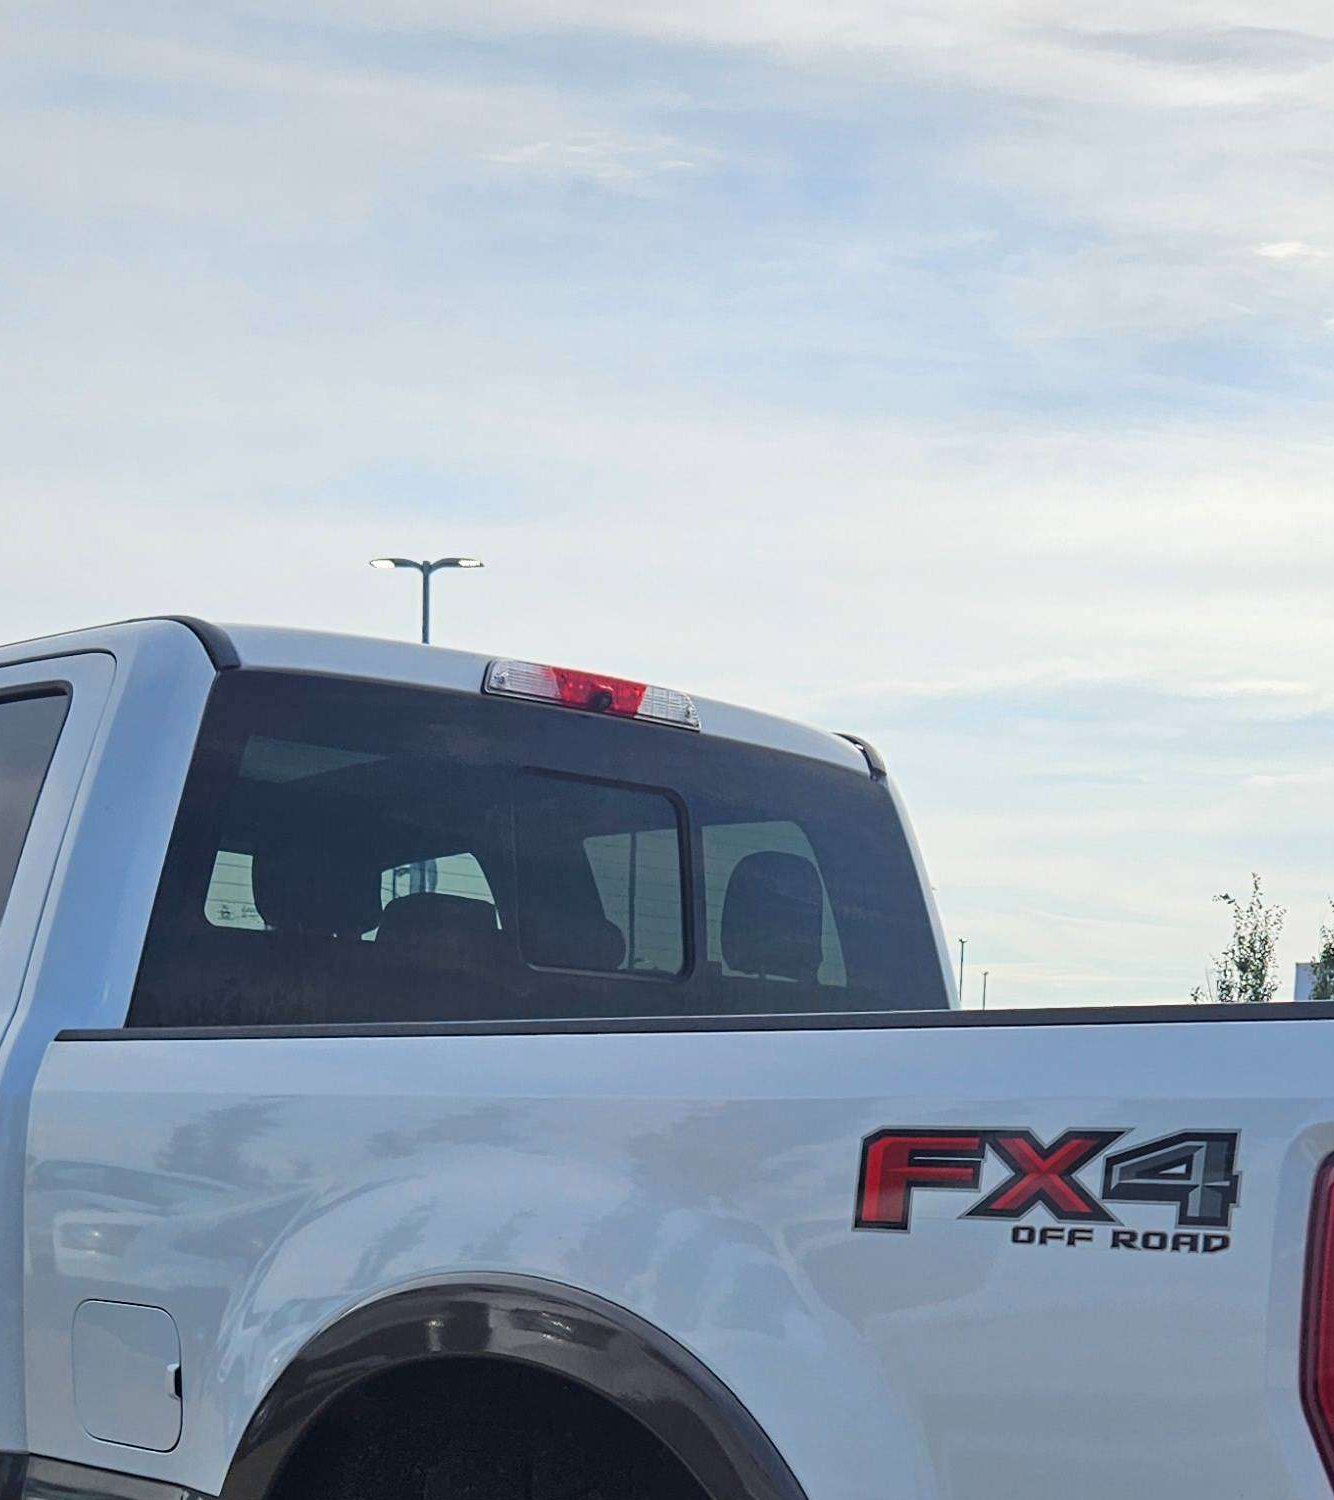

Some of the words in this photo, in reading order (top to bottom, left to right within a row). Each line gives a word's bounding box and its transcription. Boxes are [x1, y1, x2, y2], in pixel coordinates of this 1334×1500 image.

[851, 1126, 1242, 1233] FX4
[1011, 1225, 1094, 1246] OFF
[1111, 1229, 1231, 1254] ROAD
